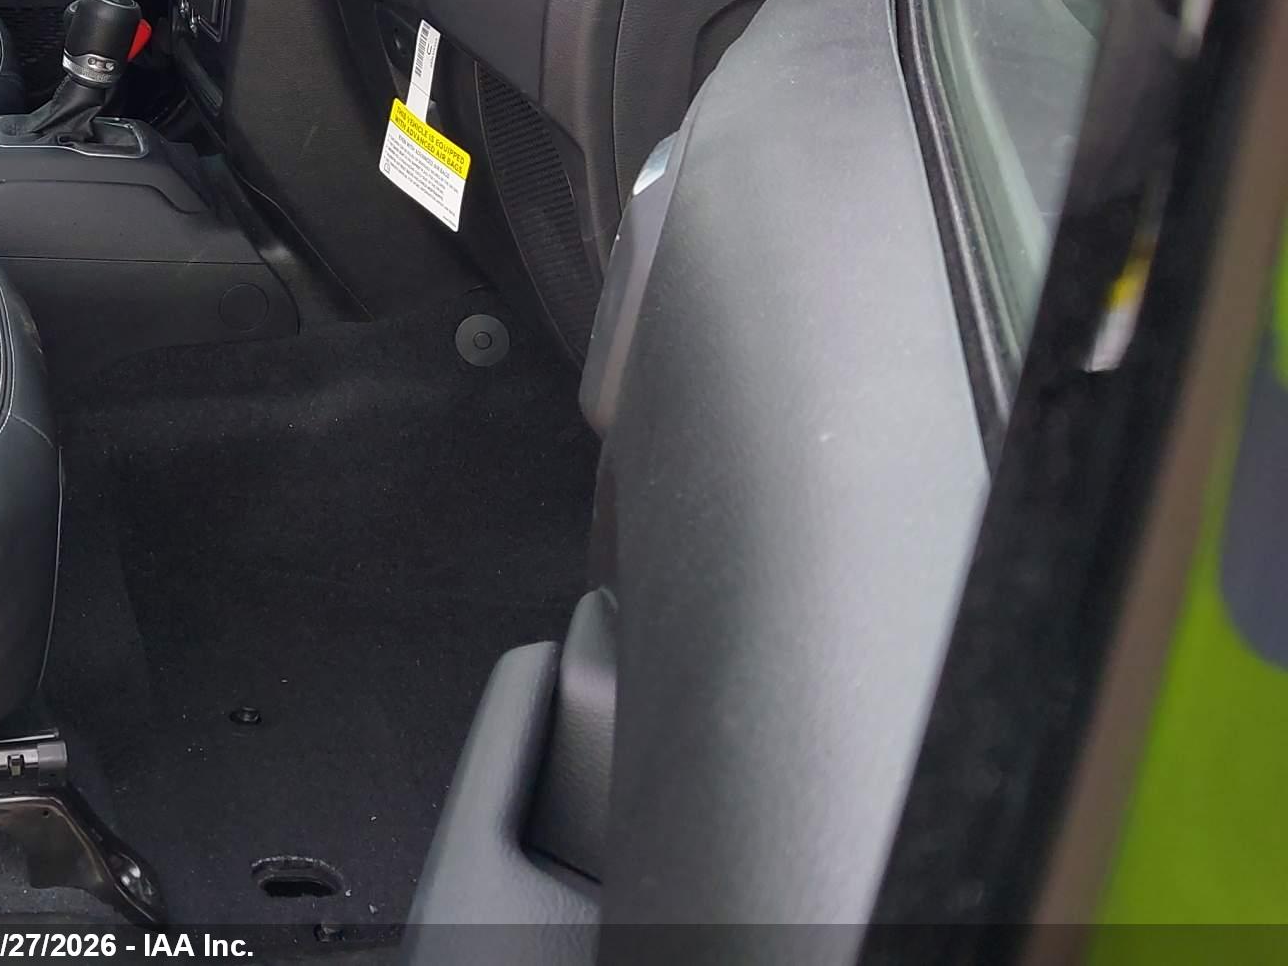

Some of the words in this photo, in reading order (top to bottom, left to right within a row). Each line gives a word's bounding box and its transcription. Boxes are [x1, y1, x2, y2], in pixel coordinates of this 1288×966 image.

[406, 129, 435, 154] ADVANCED
[435, 150, 446, 162] AIR
[446, 158, 463, 174] BAGS
[407, 116, 428, 138] VEHICLE
[435, 139, 465, 164] EQUIPPED
